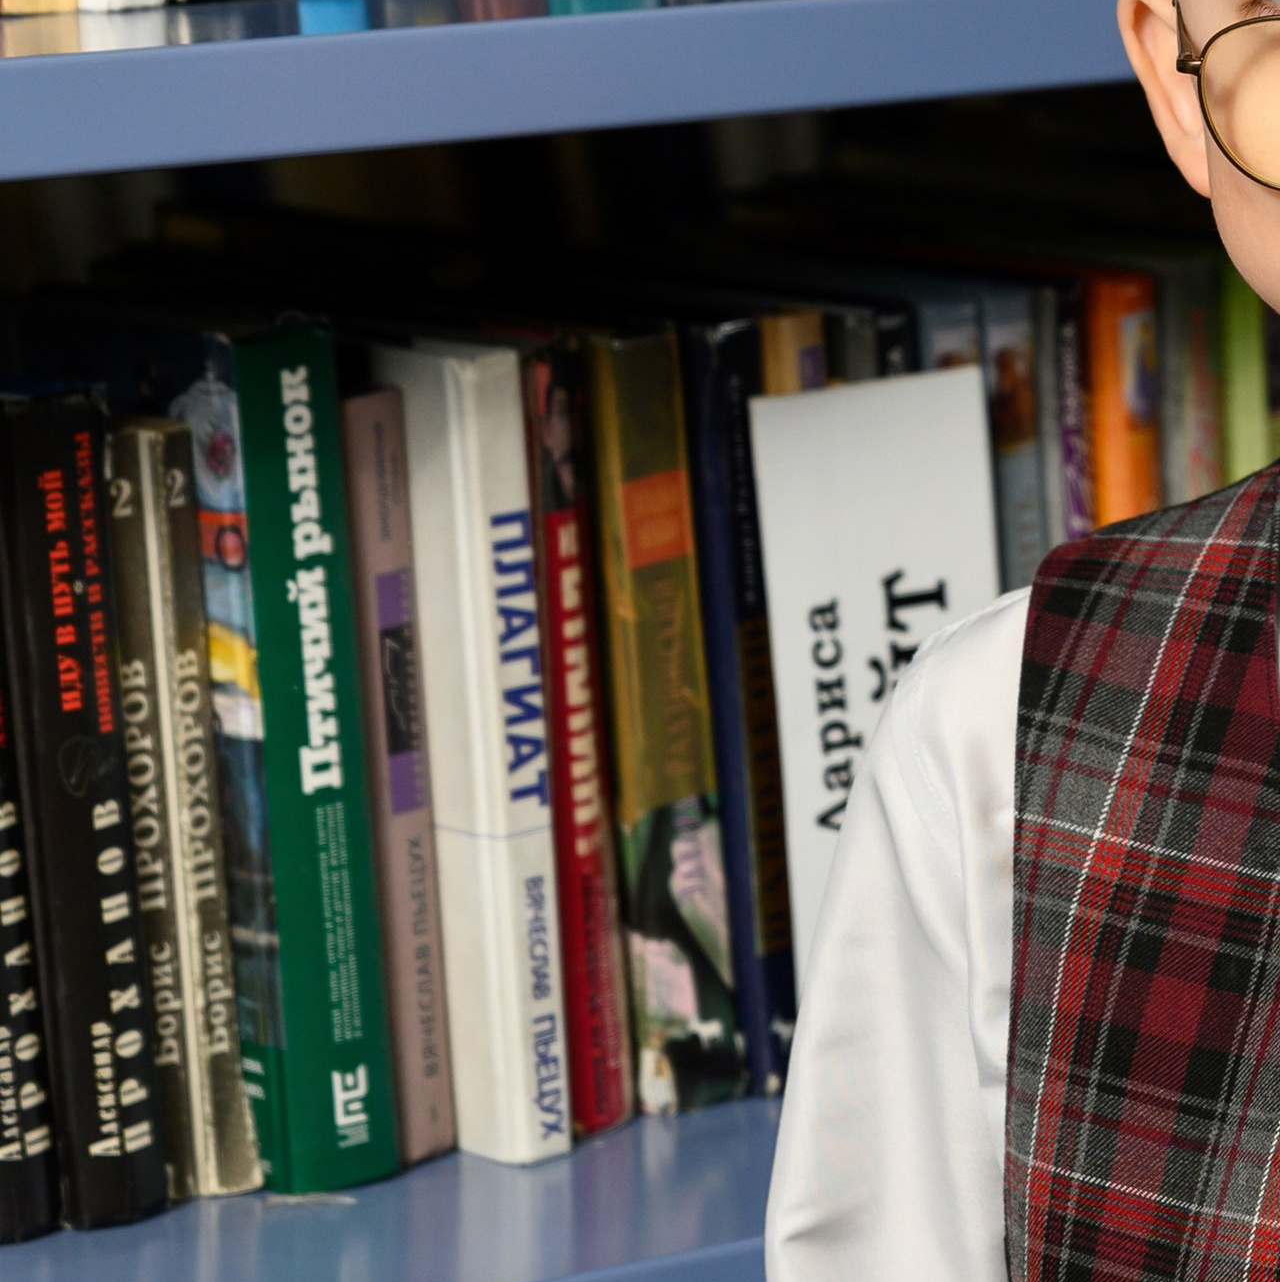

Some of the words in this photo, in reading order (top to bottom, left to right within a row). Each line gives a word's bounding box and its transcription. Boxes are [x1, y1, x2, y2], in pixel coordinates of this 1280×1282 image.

[37, 468, 69, 534] МОЙ
[110, 477, 134, 518] 2
[165, 467, 186, 509] 2
[280, 364, 334, 561] рынок
[48, 538, 76, 618] ПУТЬ
[55, 623, 77, 647] В
[57, 653, 84, 713] ИДУ
[285, 567, 343, 794] Птичий
[489, 509, 551, 807] ПЛАГИАТ
[806, 598, 863, 832] Лариса
[120, 658, 167, 912] ПРОХОРОВ
[174, 648, 218, 903] ПРОХОРОВ
[407, 836, 429, 937] ПЬЕЦУХ
[525, 874, 553, 1002] ВЯЧЕСЛАВ
[91, 797, 153, 1155] ПРОХАНОВ
[415, 945, 441, 1078] ВЯЧЕСЛАВ
[87, 1019, 123, 1158] Александр
[532, 1013, 565, 1141] ПЬЕЦУХ
